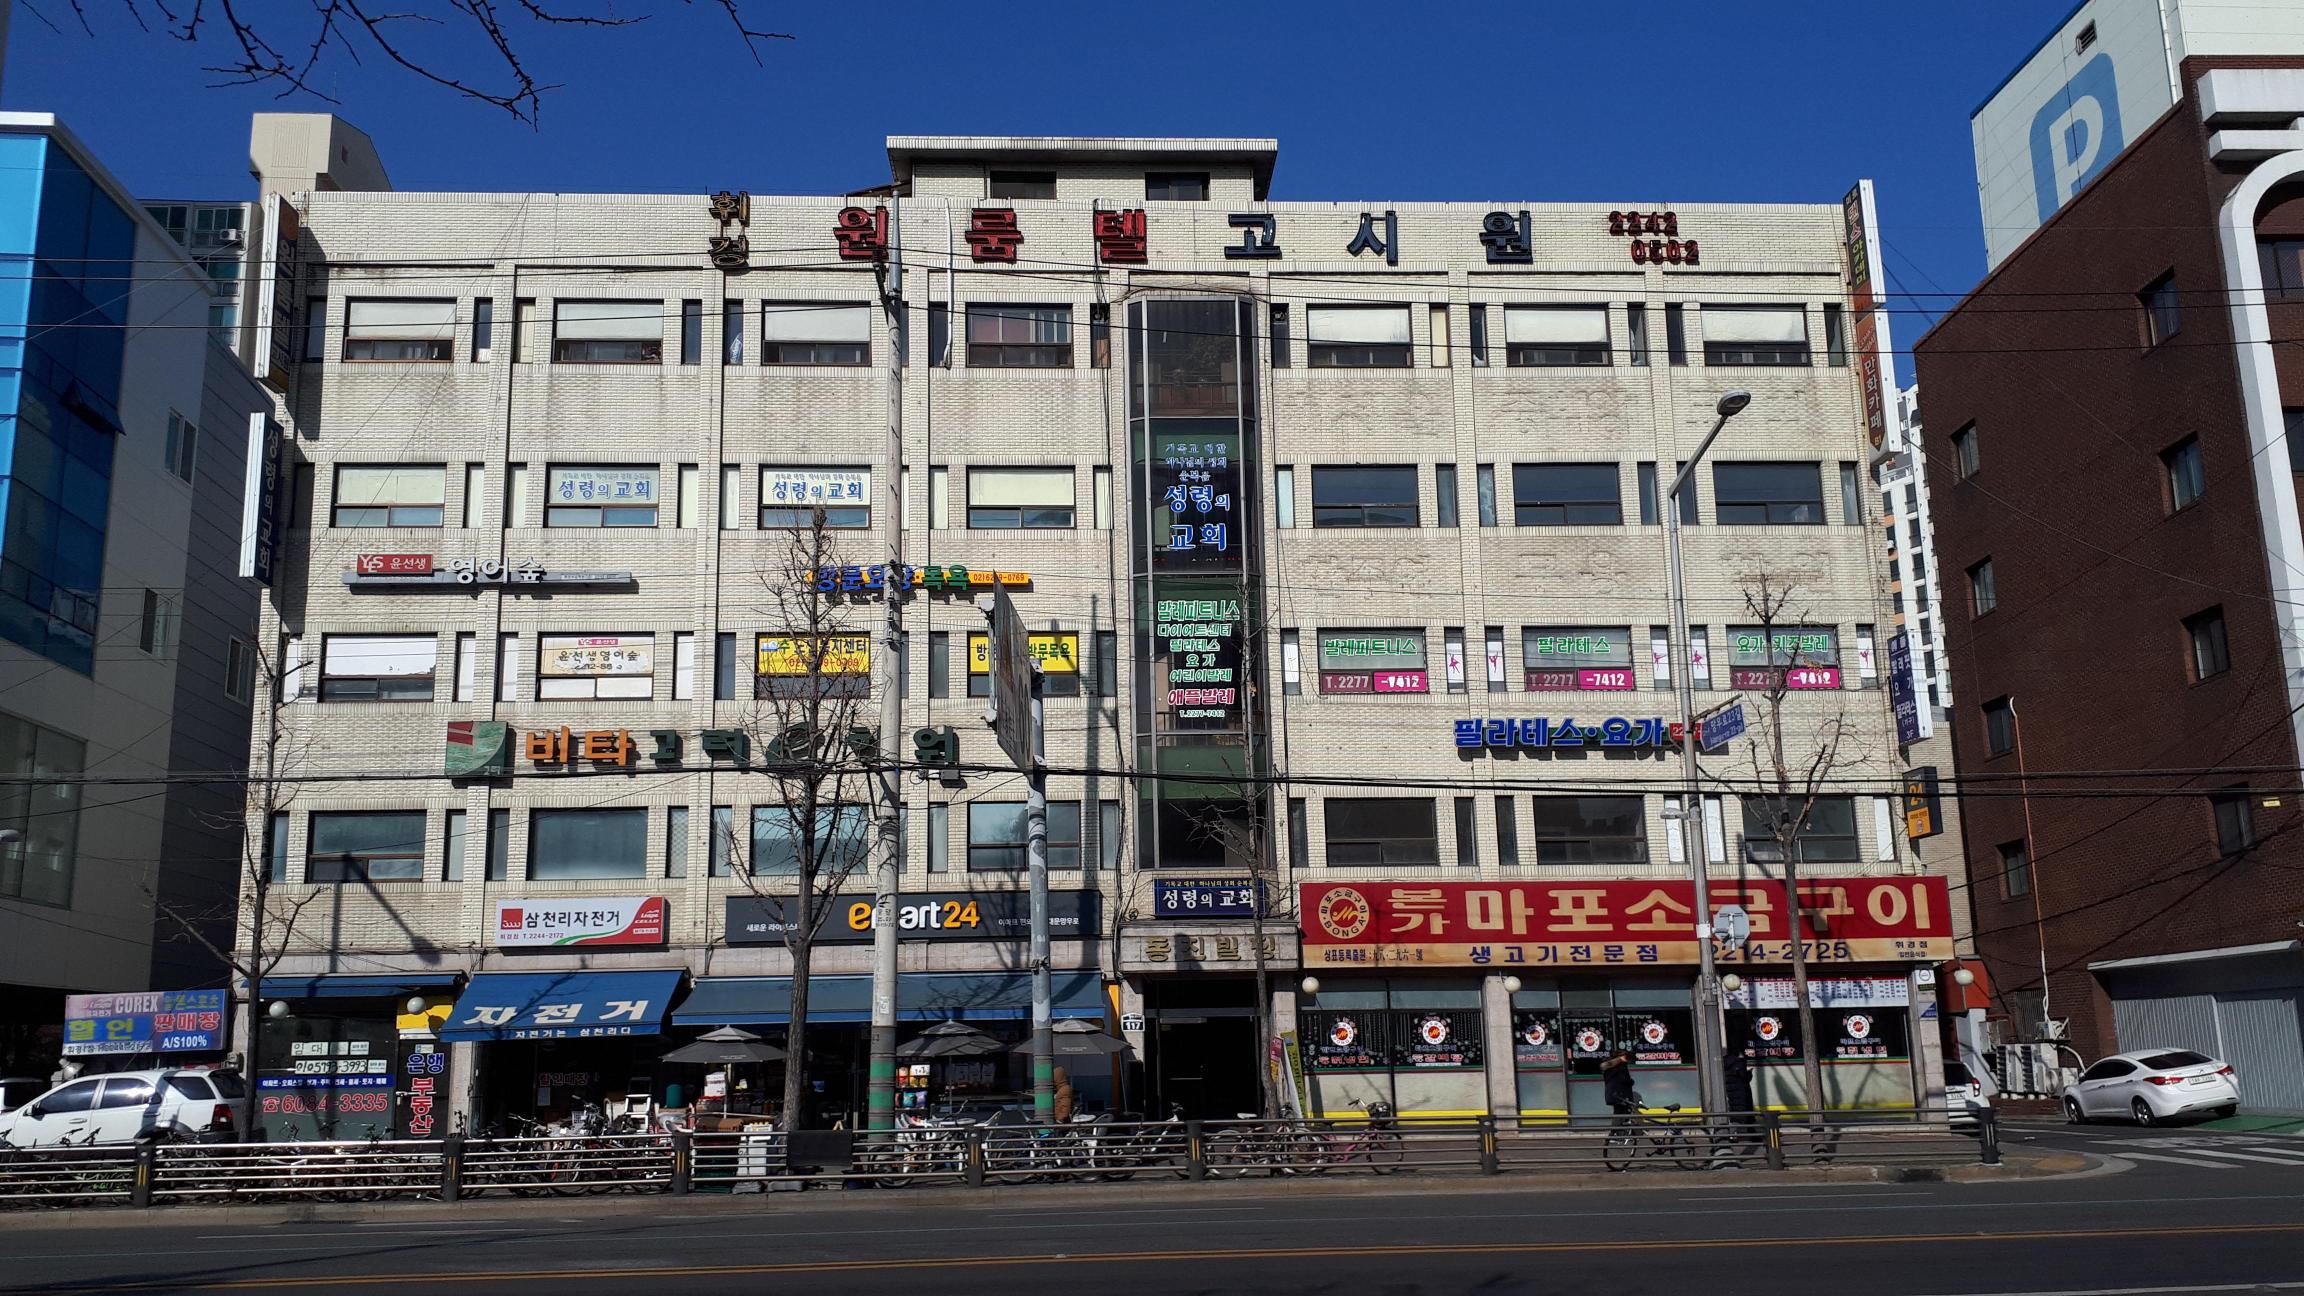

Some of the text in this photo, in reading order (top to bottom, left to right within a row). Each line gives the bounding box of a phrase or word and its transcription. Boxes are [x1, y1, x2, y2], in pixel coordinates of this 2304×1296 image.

[2048, 94, 2104, 208] P
[708, 190, 750, 270] 휘경
[1608, 210, 1679, 237] 2242
[833, 205, 1534, 266] 원룸텔 고시원
[1864, 357, 1882, 428] 만화카페
[558, 480, 652, 500] 성령의 교회
[772, 481, 864, 501] 성령의 교회
[1164, 484, 1231, 513] 성령의
[1166, 523, 1227, 551] 교회
[359, 554, 427, 573] YES 윤선생
[449, 556, 545, 584] 영어숲
[973, 573, 1025, 582] 02)629-0769
[1157, 624, 1233, 637] 다이어트센터
[1169, 639, 1221, 652] 필라테스
[1537, 636, 1611, 655] 필라테스
[1737, 635, 1763, 654] 요가
[1186, 653, 1216, 668] 요가
[1169, 668, 1233, 683] 어린이발레
[1325, 674, 1370, 689] T.2277
[1529, 672, 1626, 688] T.2277 -7412
[1167, 688, 1236, 706] 애플발레
[526, 726, 632, 768] 비타
[1163, 888, 1254, 910] 성령의 교회
[525, 909, 620, 929] 삼천리자전거
[848, 901, 981, 930] eart24
[1324, 918, 1367, 938] BONGA
[1469, 942, 1659, 965] 생고기전문점
[115, 995, 159, 1014] COREX
[463, 1000, 649, 1026] 자전거
[68, 1011, 221, 1041] 할인 판매장
[515, 1029, 567, 1039] 자전거는
[1125, 1022, 1141, 1030] 117
[162, 1035, 208, 1049] A/S100%
[406, 1053, 445, 1075] 은행
[282, 1093, 388, 1113] 6084-3335
[410, 1077, 434, 1135] 부동산
